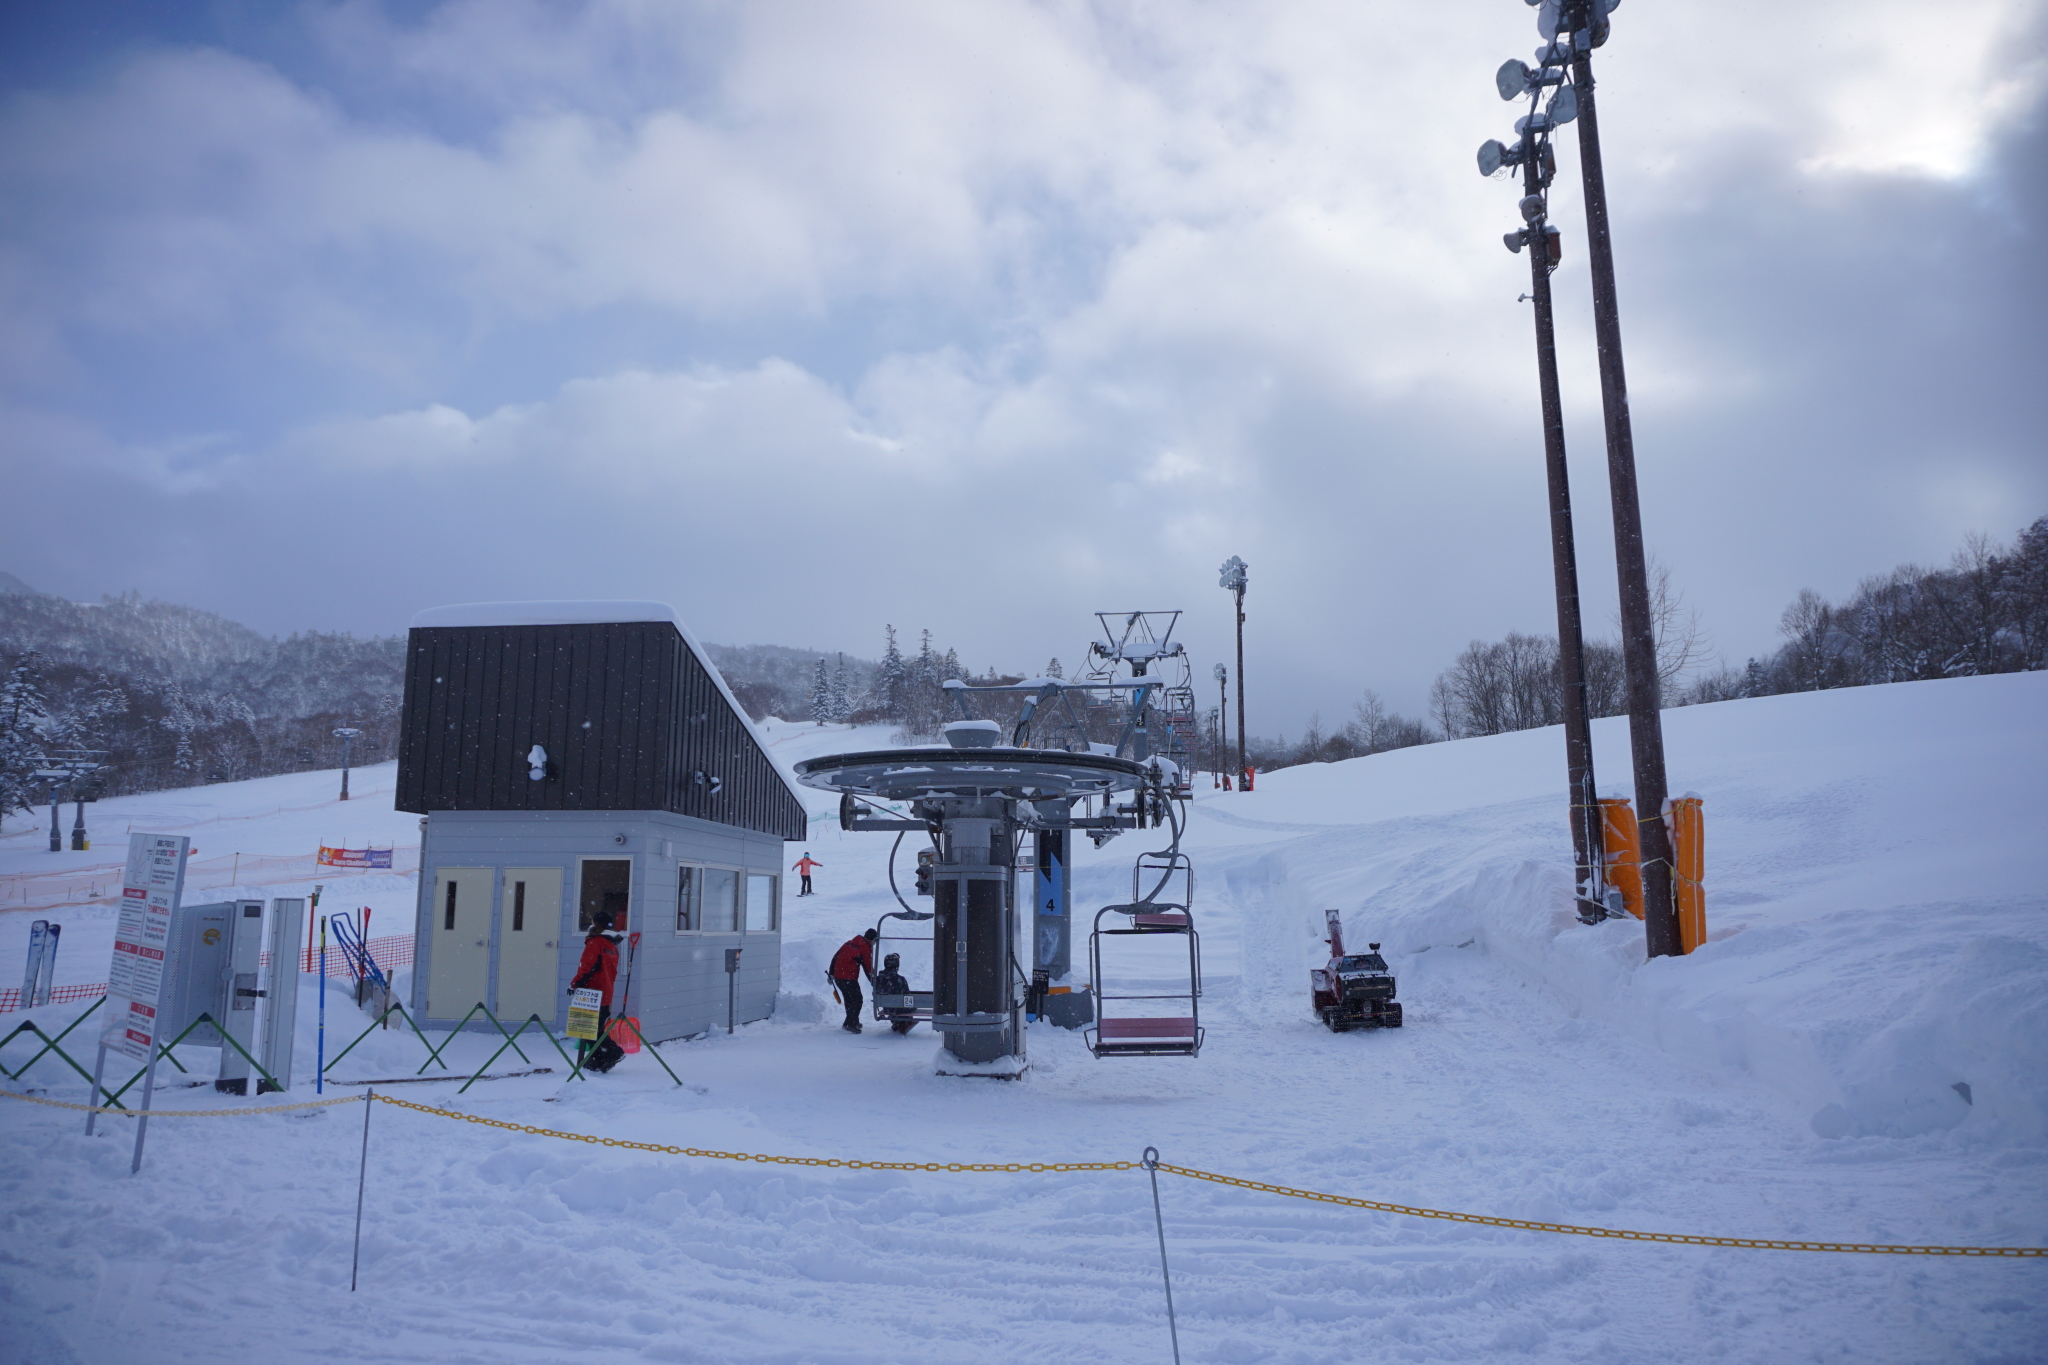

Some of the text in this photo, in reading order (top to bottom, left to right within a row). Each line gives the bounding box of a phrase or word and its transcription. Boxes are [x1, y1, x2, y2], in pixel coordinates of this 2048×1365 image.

[342, 851, 367, 859] ACADEMY
[1046, 898, 1055, 911] 4
[576, 990, 599, 998] このリフトは
[904, 997, 913, 1005] 24
